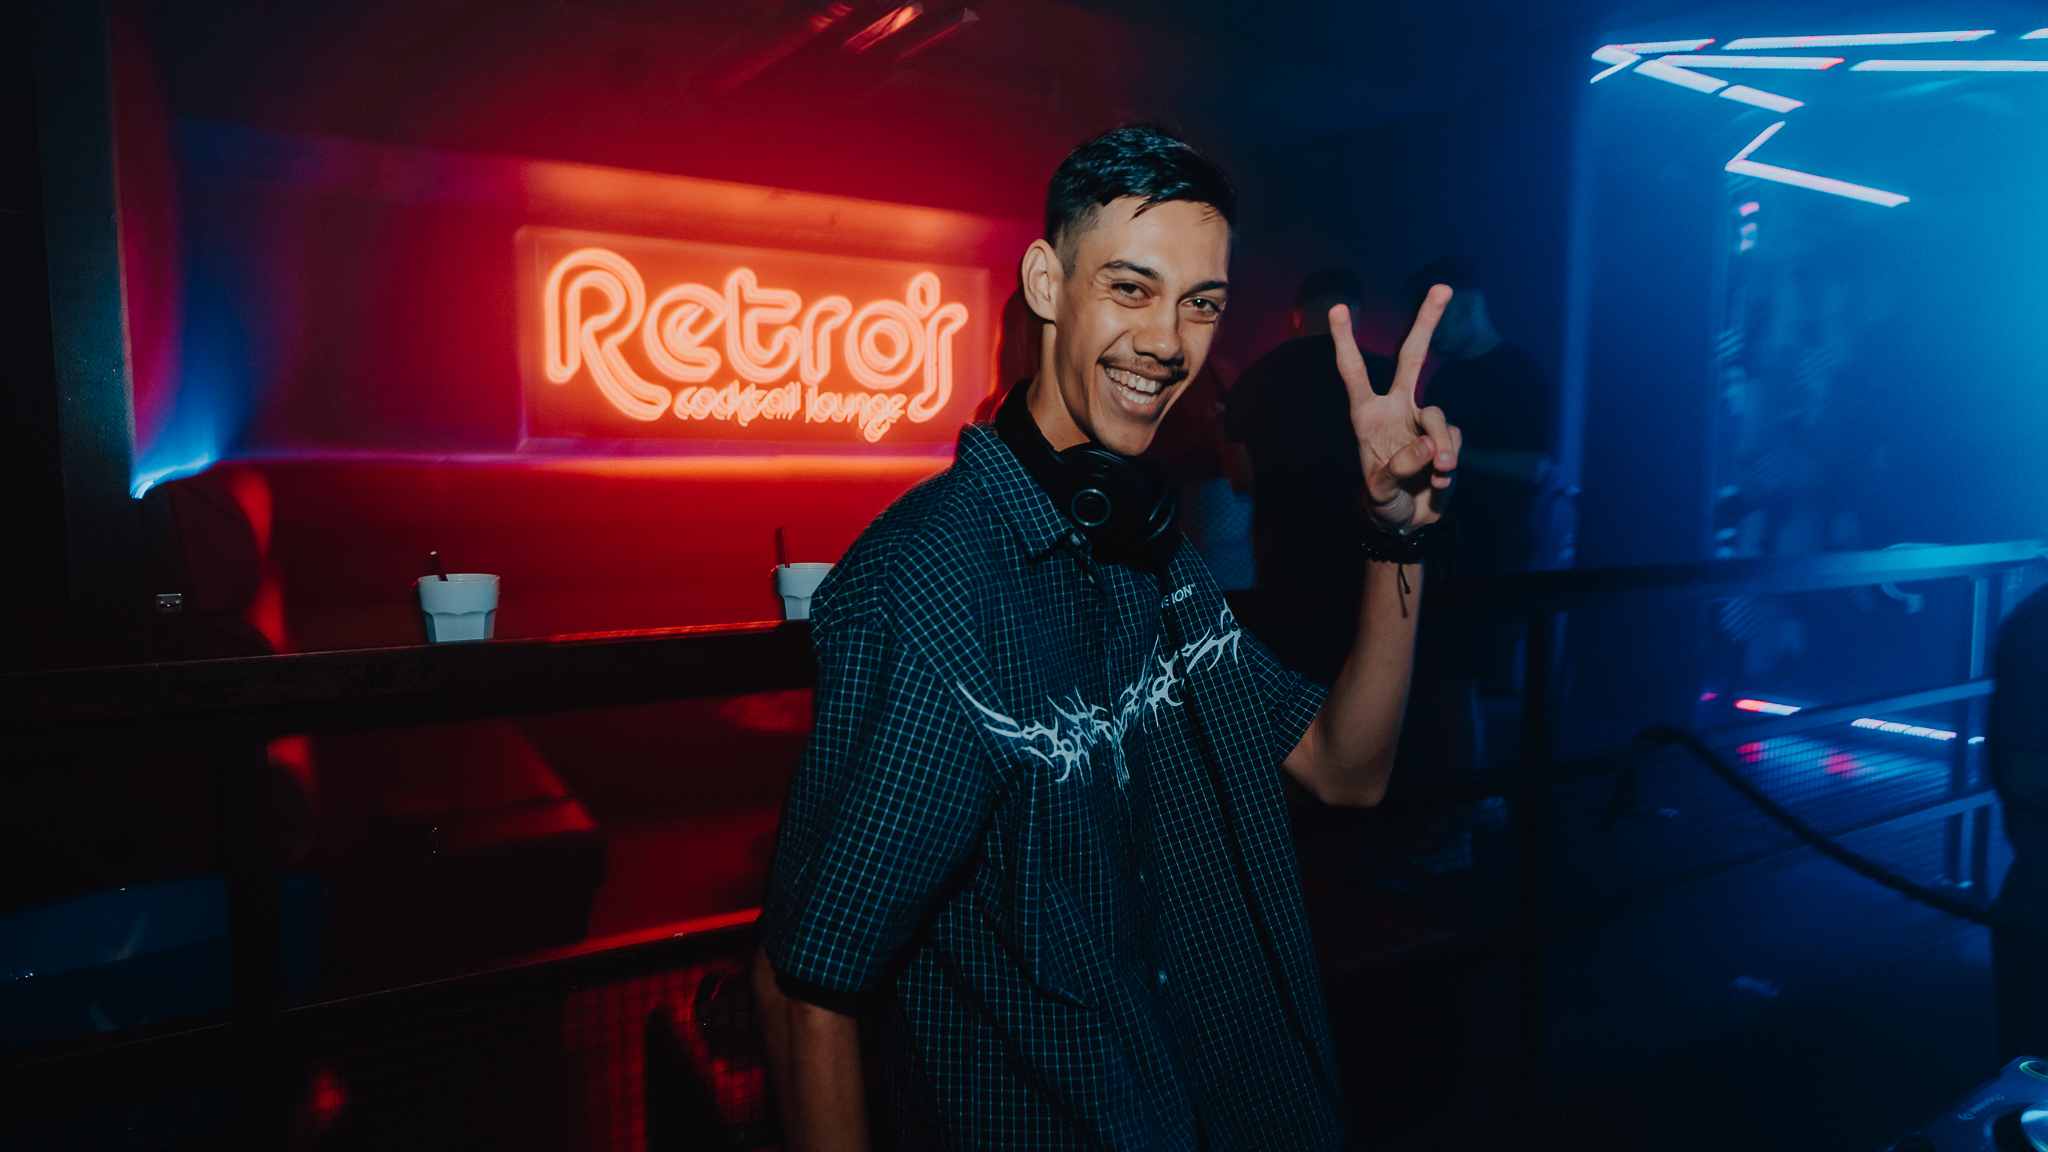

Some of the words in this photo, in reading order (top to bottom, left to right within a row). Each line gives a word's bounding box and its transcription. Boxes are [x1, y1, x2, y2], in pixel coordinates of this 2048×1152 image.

[545, 247, 968, 422] Retro's
[674, 380, 800, 426] cocktail
[806, 385, 907, 442] lounge
